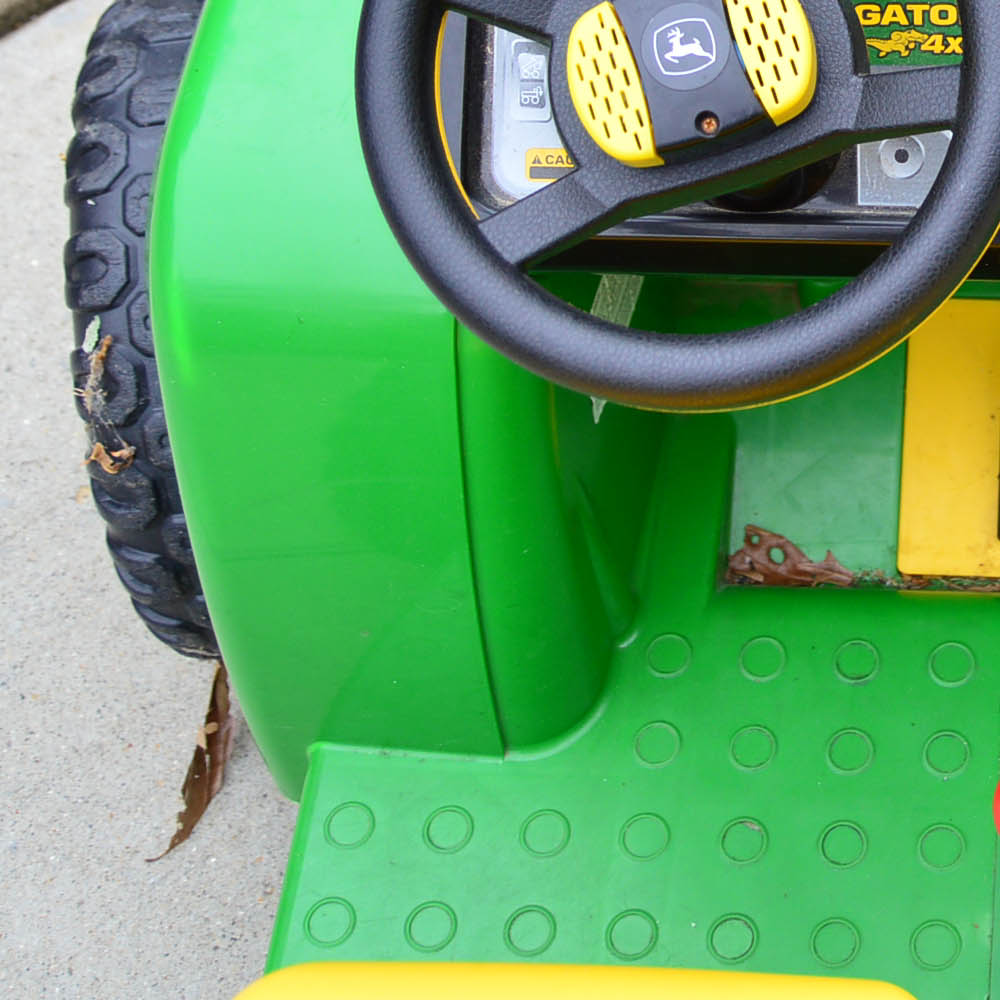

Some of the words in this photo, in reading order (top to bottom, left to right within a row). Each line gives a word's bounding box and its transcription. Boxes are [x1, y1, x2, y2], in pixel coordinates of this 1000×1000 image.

[854, 3, 959, 26] GATO
[920, 34, 964, 54] 4x
[545, 154, 573, 165] CAU
